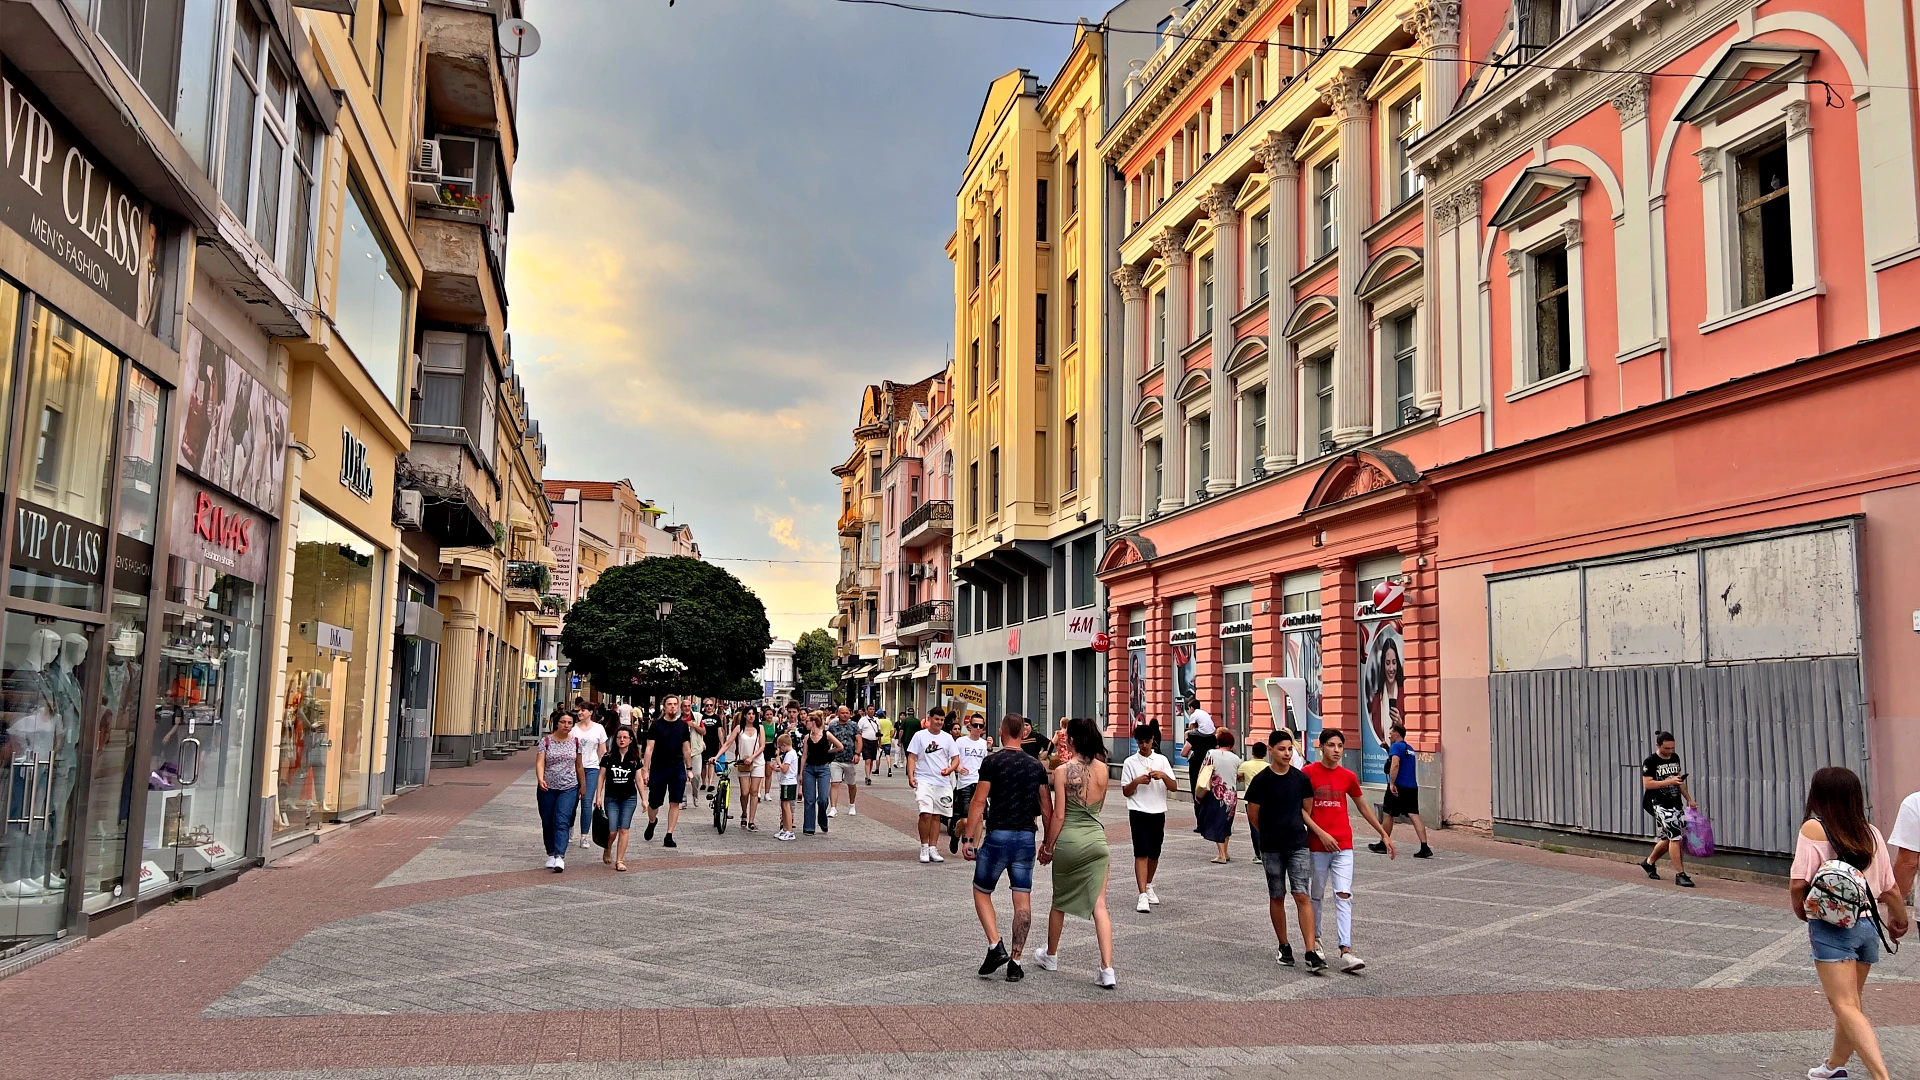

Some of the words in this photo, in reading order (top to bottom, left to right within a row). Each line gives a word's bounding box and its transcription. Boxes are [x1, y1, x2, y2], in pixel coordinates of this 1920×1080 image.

[2, 76, 54, 196] VIP
[62, 146, 142, 276] CLASS
[30, 212, 65, 257] MEN'S
[65, 240, 109, 292] FASHION
[19, 507, 48, 560] VIP
[52, 521, 101, 576] CLASS
